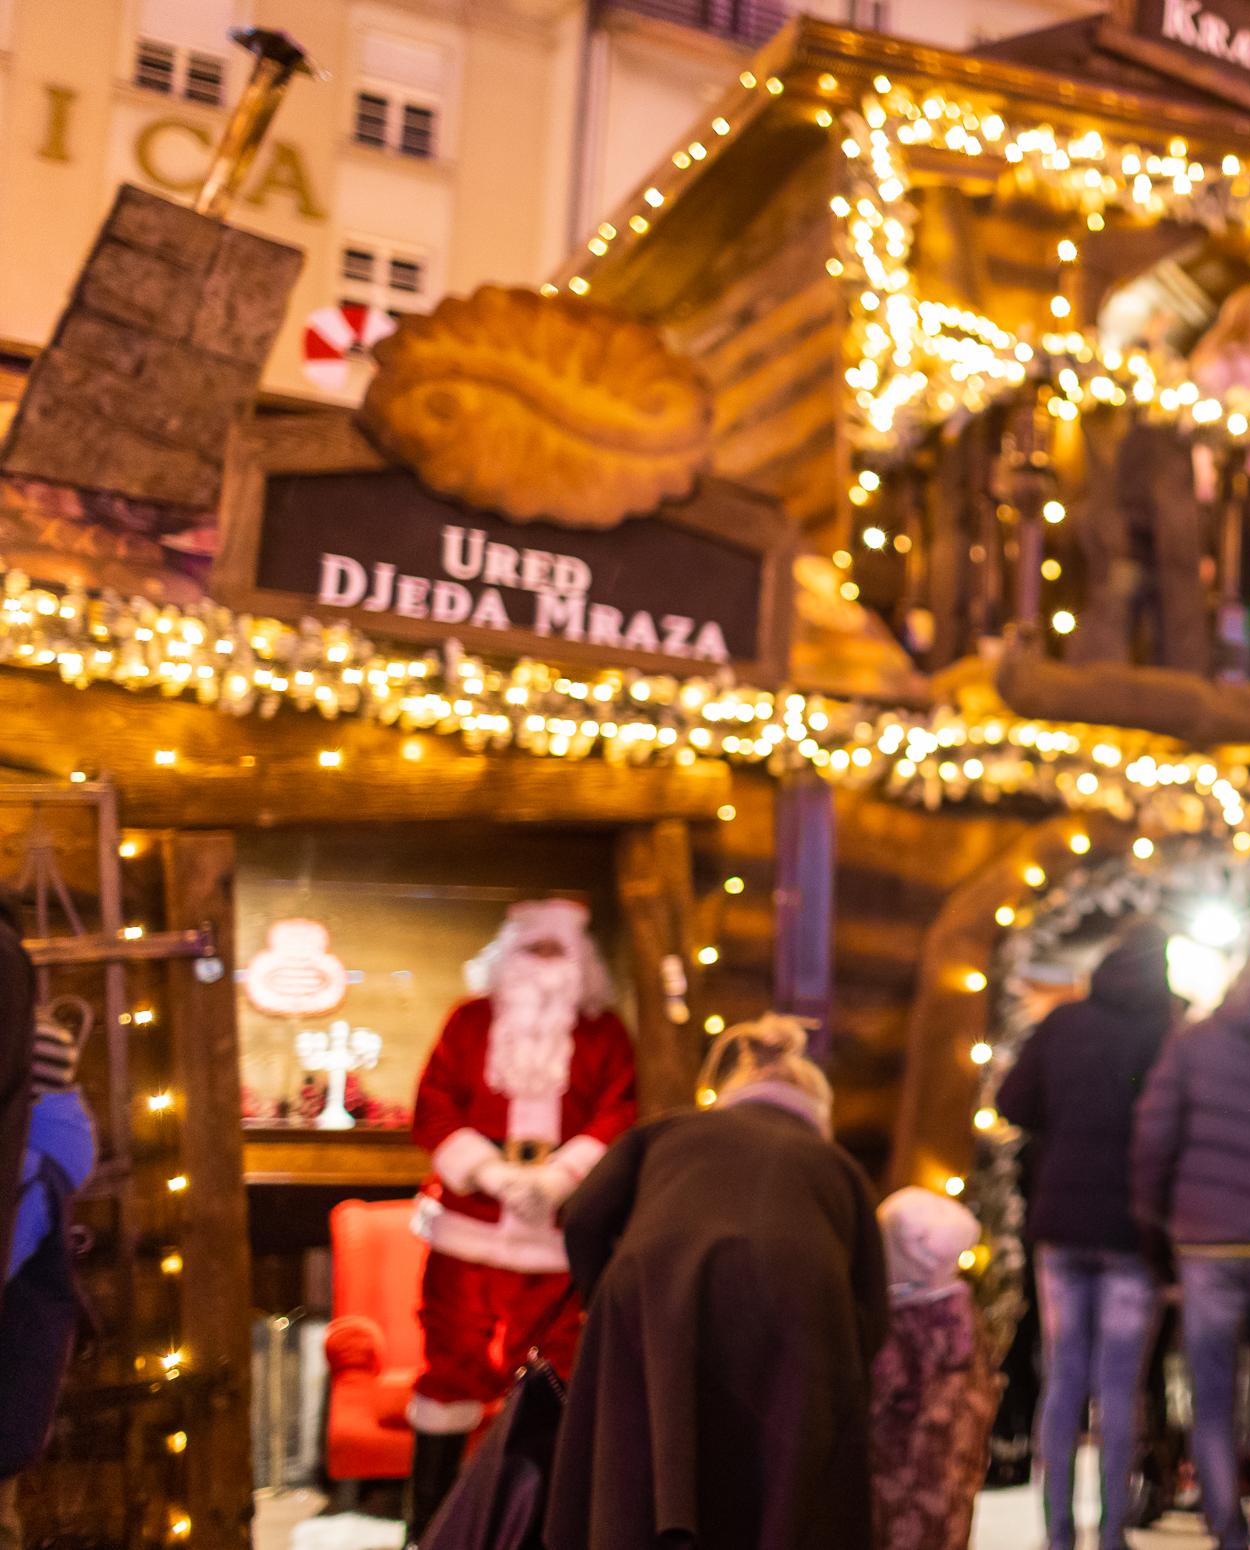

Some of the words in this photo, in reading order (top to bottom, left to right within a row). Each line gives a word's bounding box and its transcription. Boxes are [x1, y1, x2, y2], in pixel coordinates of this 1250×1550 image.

[442, 524, 592, 595] URED
[319, 552, 509, 632] DJEDA
[534, 590, 729, 664] MRAZA
